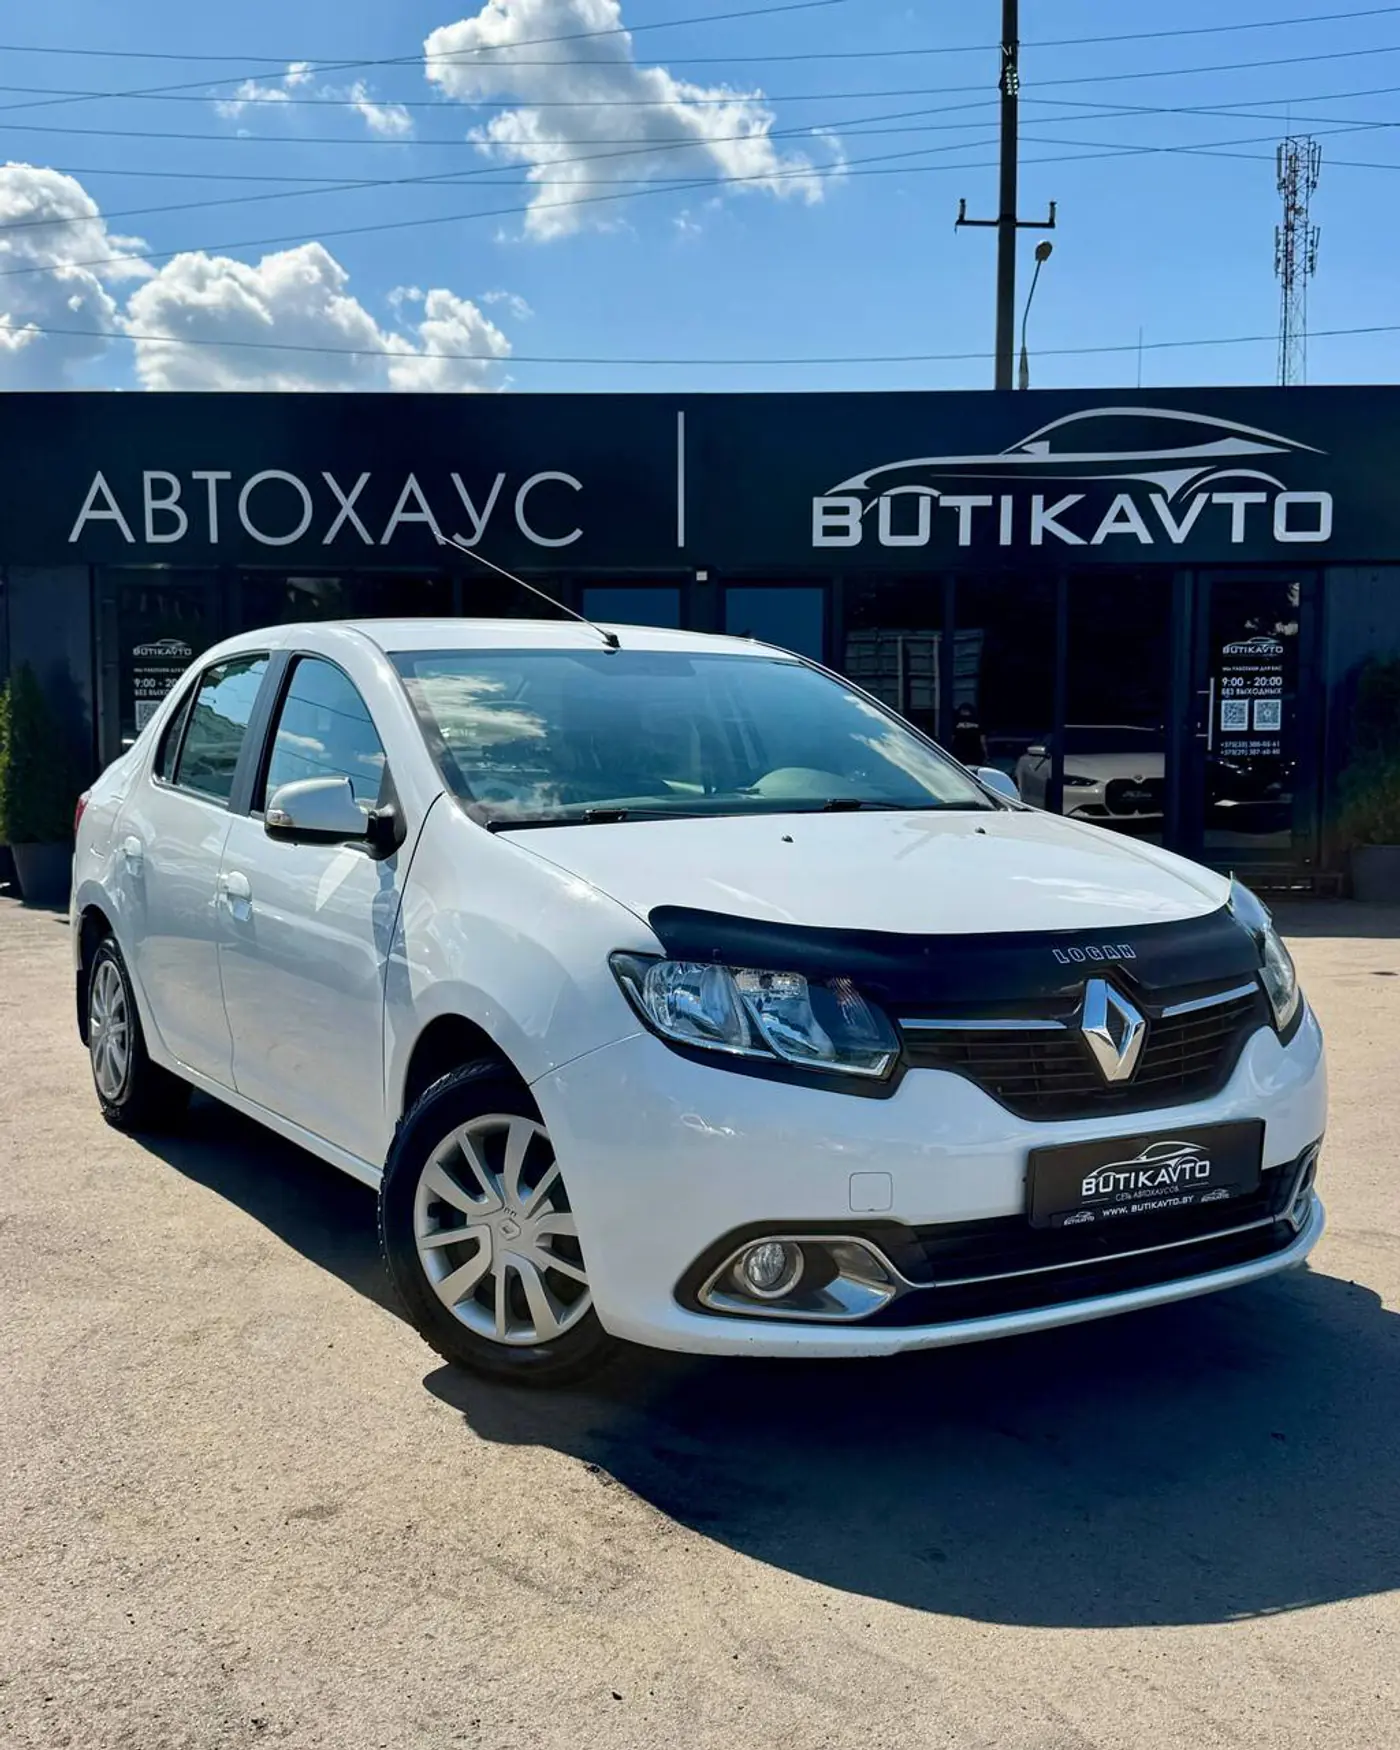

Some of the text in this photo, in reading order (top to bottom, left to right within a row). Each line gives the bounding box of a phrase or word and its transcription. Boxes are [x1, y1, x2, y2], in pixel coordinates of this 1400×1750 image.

[68, 469, 584, 548] АВТОХАУС
[812, 490, 1334, 547] BUTIKAVTO
[132, 647, 193, 656] BUTIKAVTO
[1222, 645, 1284, 654] BUTIKAVTO
[134, 678, 156, 688] 9:00
[1222, 676, 1244, 686] 9:00
[1254, 676, 1283, 686] 20:00
[1052, 944, 1137, 964] LOGAN
[1082, 1160, 1210, 1196] BUTIKAVTO
[1130, 1195, 1194, 1213] BUTIKAVTO.BY
